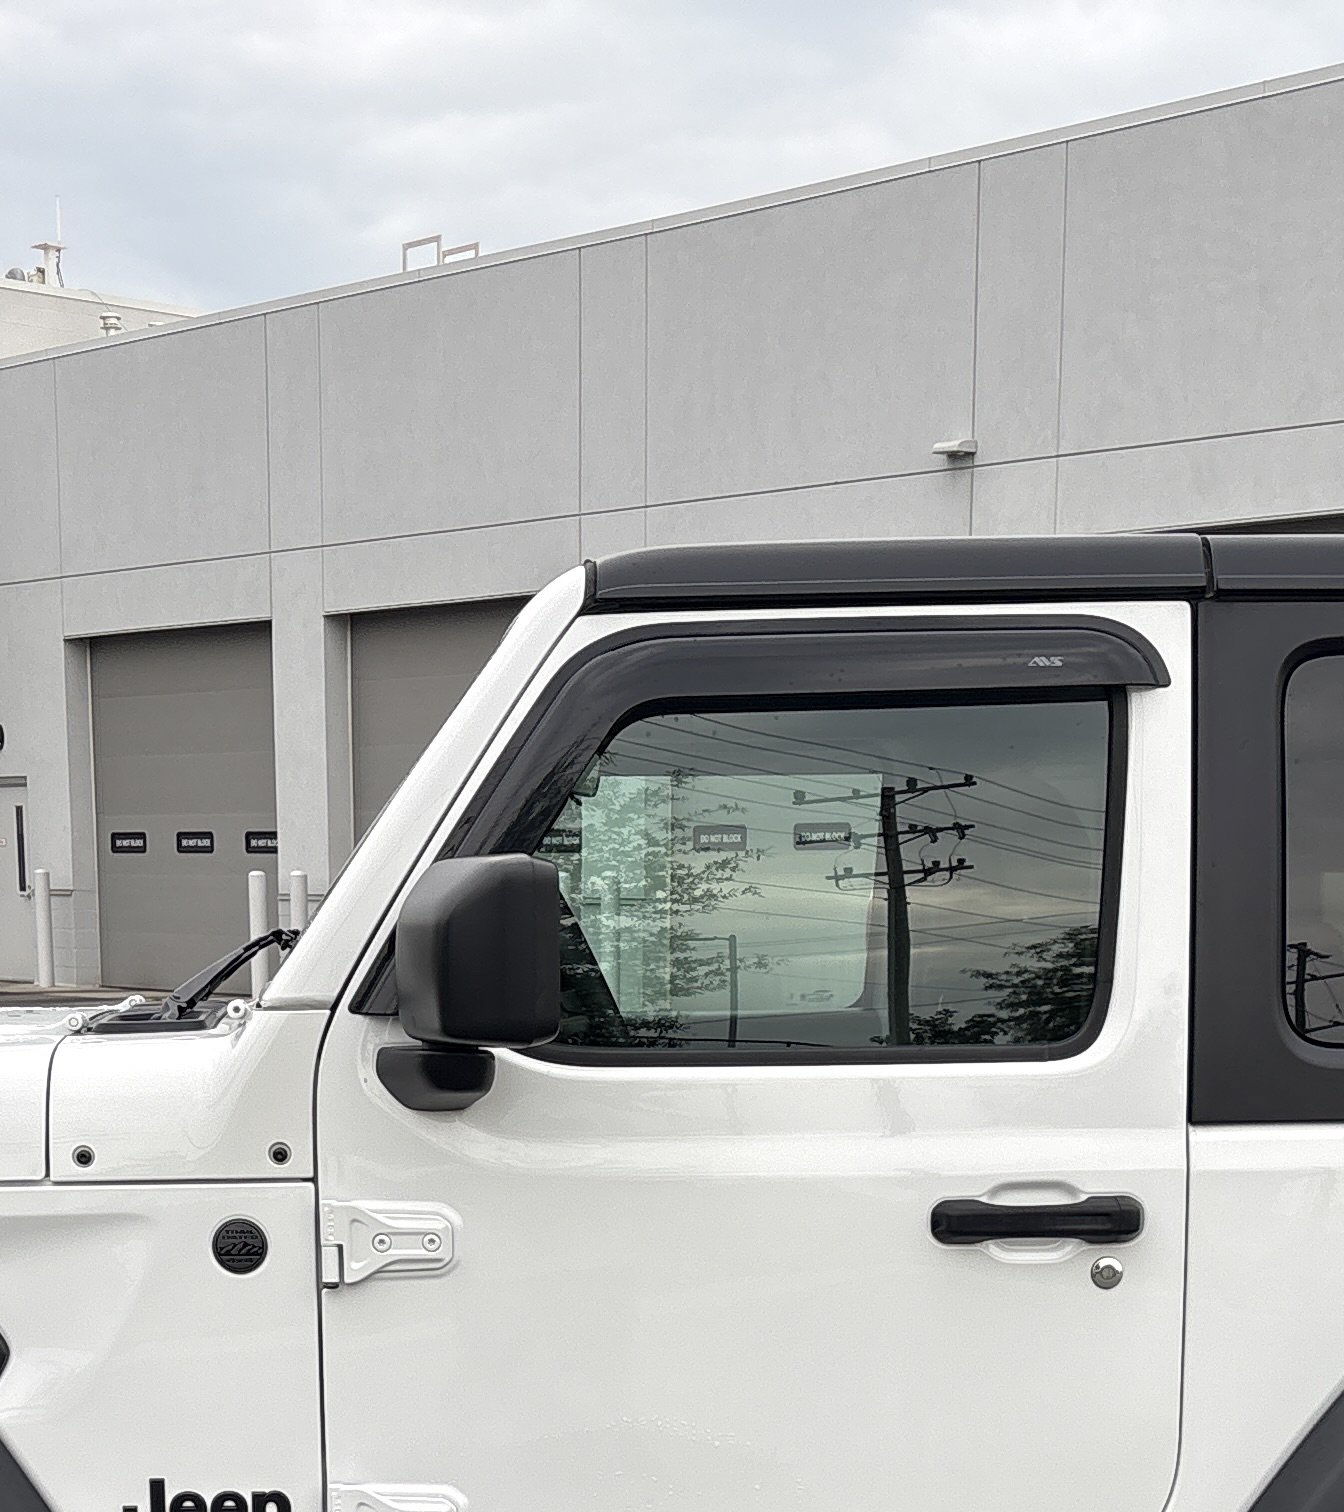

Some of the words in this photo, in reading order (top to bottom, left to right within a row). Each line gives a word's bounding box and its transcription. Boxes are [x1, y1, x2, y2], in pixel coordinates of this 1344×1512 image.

[700, 834, 709, 844] DO
[710, 834, 722, 843] NOT
[723, 834, 742, 843] BLOCK
